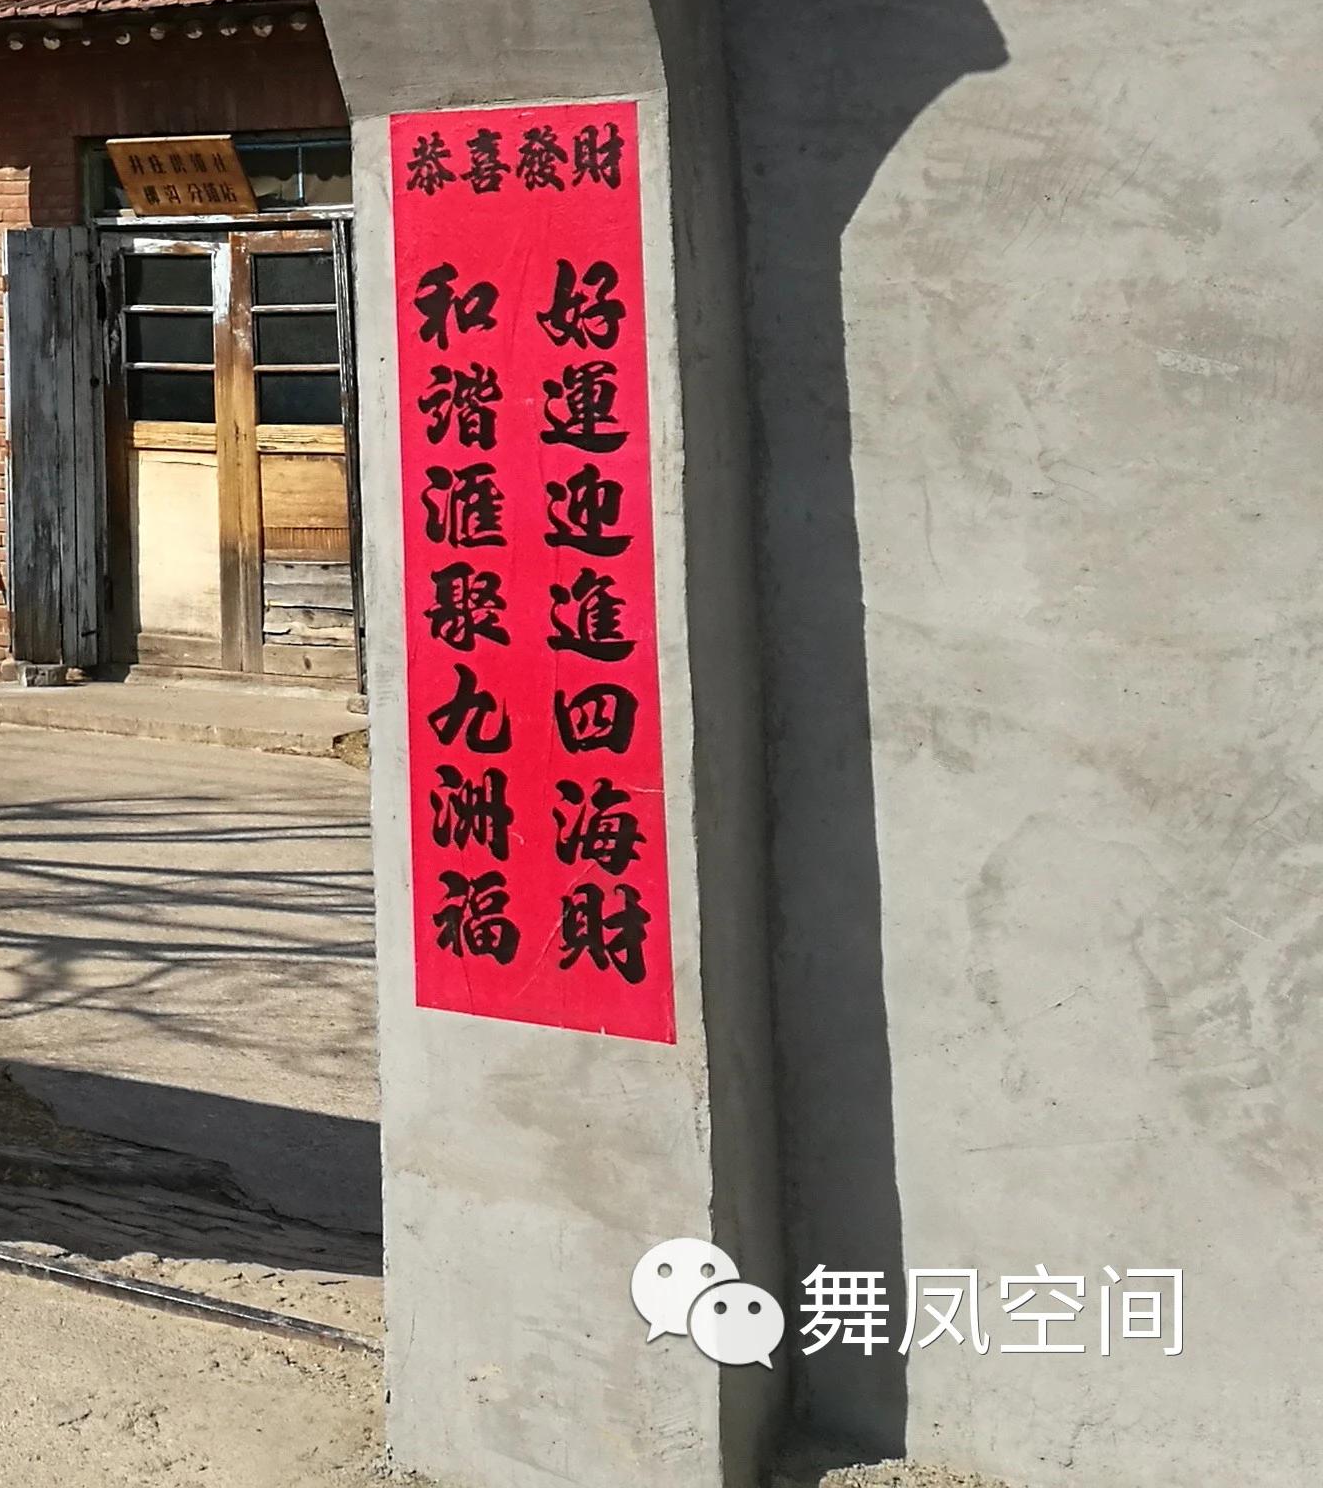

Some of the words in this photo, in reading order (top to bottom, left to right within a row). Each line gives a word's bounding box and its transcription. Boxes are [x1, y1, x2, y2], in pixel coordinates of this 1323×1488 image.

[406, 123, 623, 194] 恭喜發財
[535, 257, 649, 986] 好運迎進四海財
